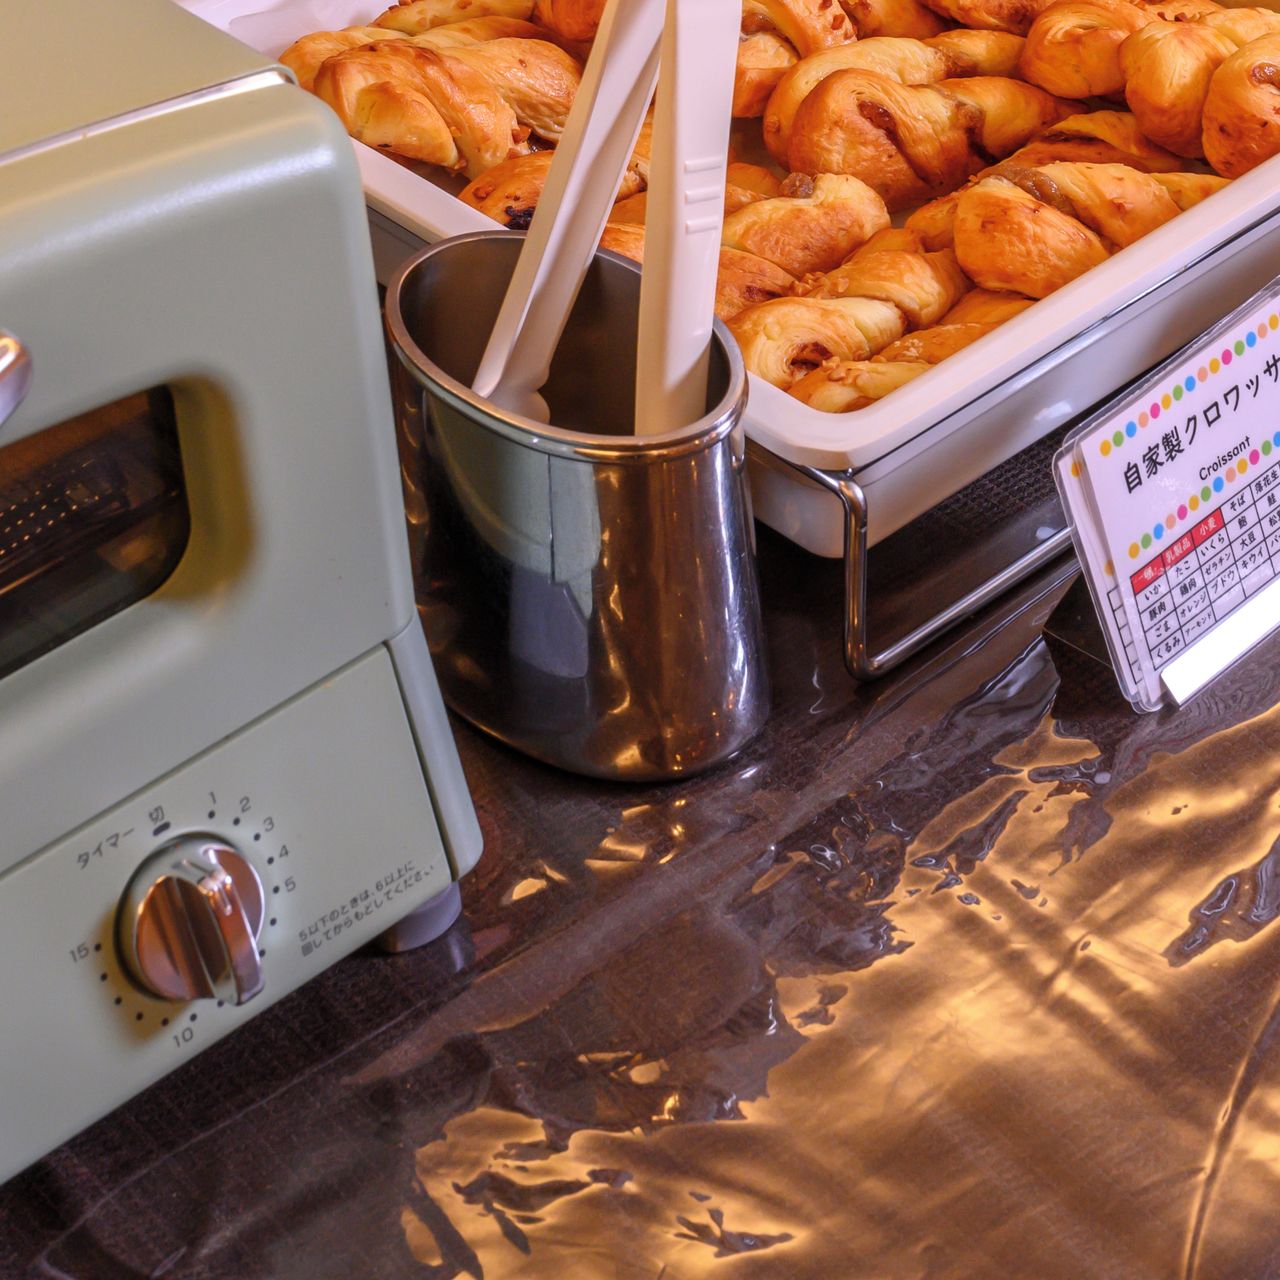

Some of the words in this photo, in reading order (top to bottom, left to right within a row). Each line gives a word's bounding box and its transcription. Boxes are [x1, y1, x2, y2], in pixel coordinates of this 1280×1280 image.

[1199, 436, 1251, 481] Croissant
[1200, 518, 1217, 536] 小麦
[1230, 494, 1245, 512] そば
[1205, 552, 1231, 576] ゼラチン
[1240, 531, 1256, 551] 大豆
[1145, 584, 1161, 601] いか
[1175, 560, 1191, 578] たこ
[1201, 534, 1225, 556] いくら
[1154, 622, 1171, 638] ごま
[1180, 592, 1206, 618] オレンジ
[1211, 570, 1235, 594] ブドウ
[1241, 547, 1265, 570] キウイ
[1157, 636, 1180, 658] くるみ
[1185, 611, 1212, 636] アーモンド
[209, 792, 217, 804] 1
[239, 796, 252, 812] 2
[148, 806, 165, 824] 切
[263, 817, 275, 833] 3
[77, 827, 135, 869] タイマー
[278, 845, 290, 859] 4
[285, 878, 297, 893] 5
[69, 944, 90, 963] 15
[173, 1027, 194, 1048] 10
